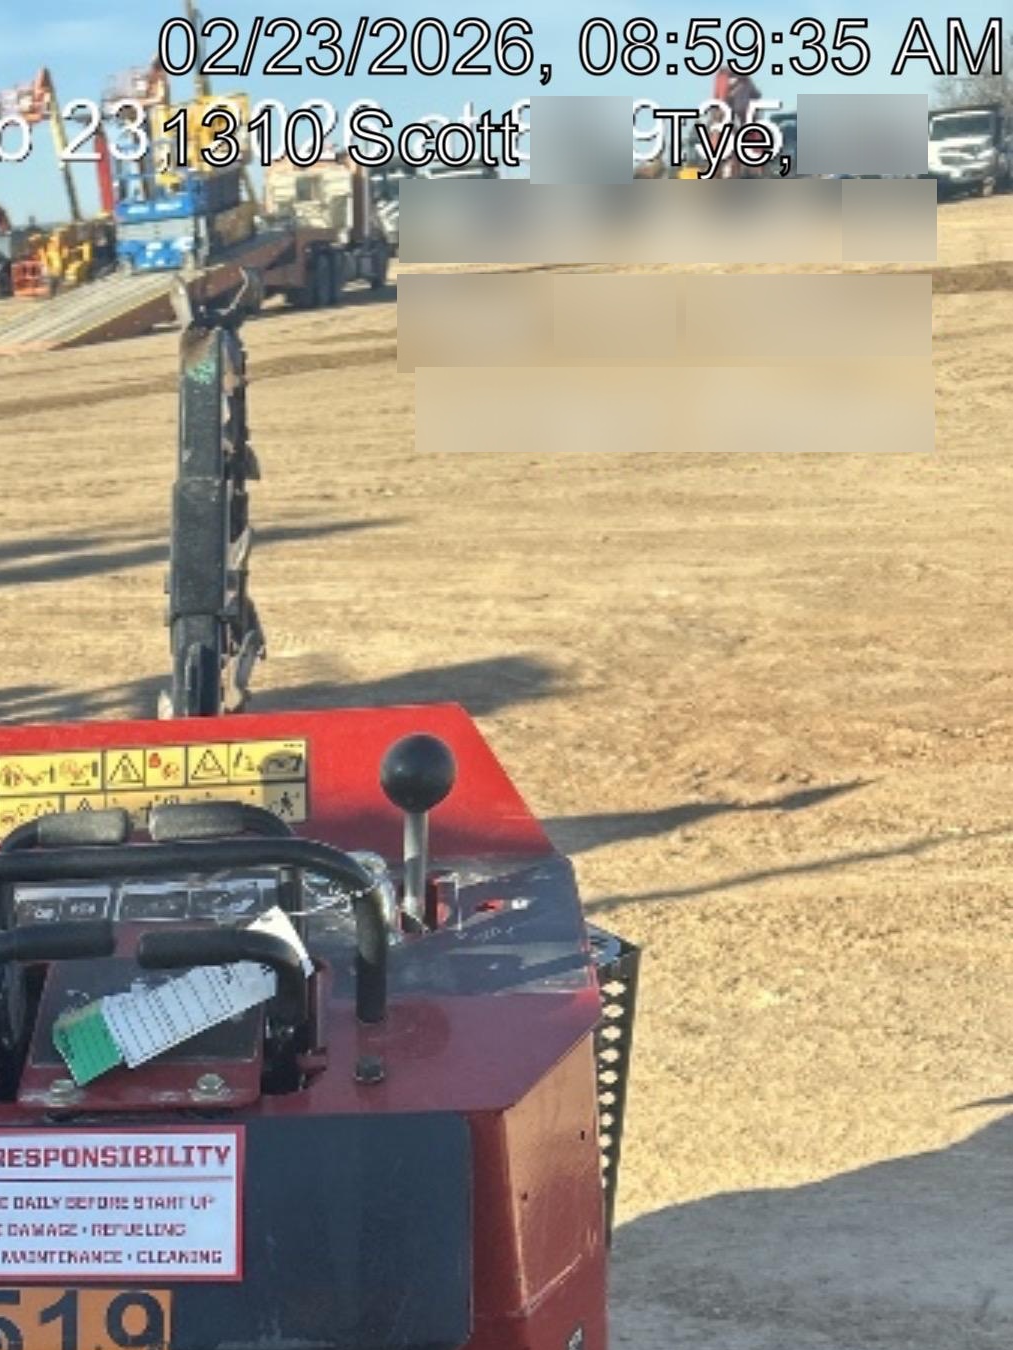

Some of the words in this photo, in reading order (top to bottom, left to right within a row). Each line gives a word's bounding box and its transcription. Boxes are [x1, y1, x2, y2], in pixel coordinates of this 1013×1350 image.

[13, 1196, 62, 1210] DAILY
[64, 1196, 129, 1210] BEFORE
[133, 1195, 185, 1210] START
[7, 1223, 78, 1238] DAMAGE
[91, 1222, 186, 1237] REFUELING
[1, 1250, 123, 1265] MAINTENANCE
[136, 1250, 223, 1265] CLEANING
